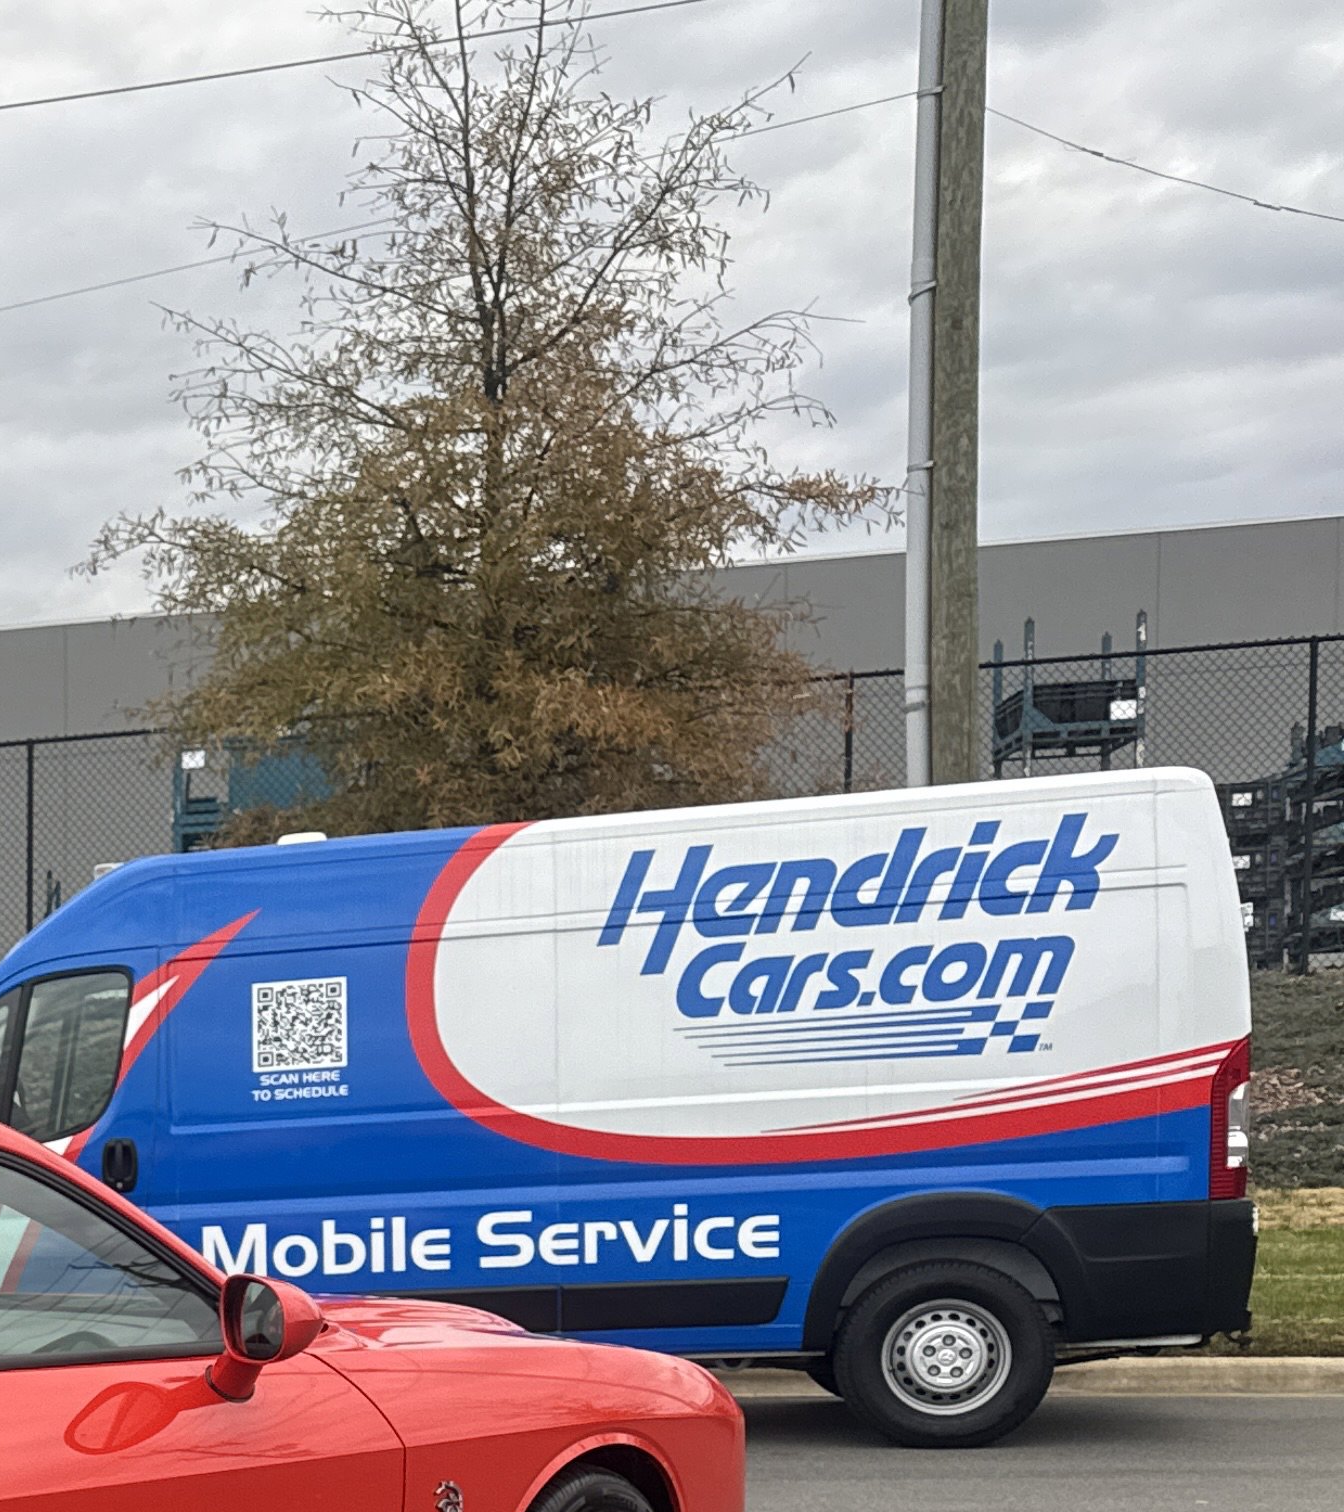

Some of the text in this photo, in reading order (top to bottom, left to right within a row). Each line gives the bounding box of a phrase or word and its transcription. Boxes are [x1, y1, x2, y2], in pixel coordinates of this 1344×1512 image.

[597, 812, 1119, 975] Hendrick
[676, 935, 1075, 1018] Cars.com
[251, 1085, 349, 1101] TO SCHEDULE
[260, 1070, 340, 1086] SCAN HERE
[202, 1203, 780, 1278] Mobile Service
